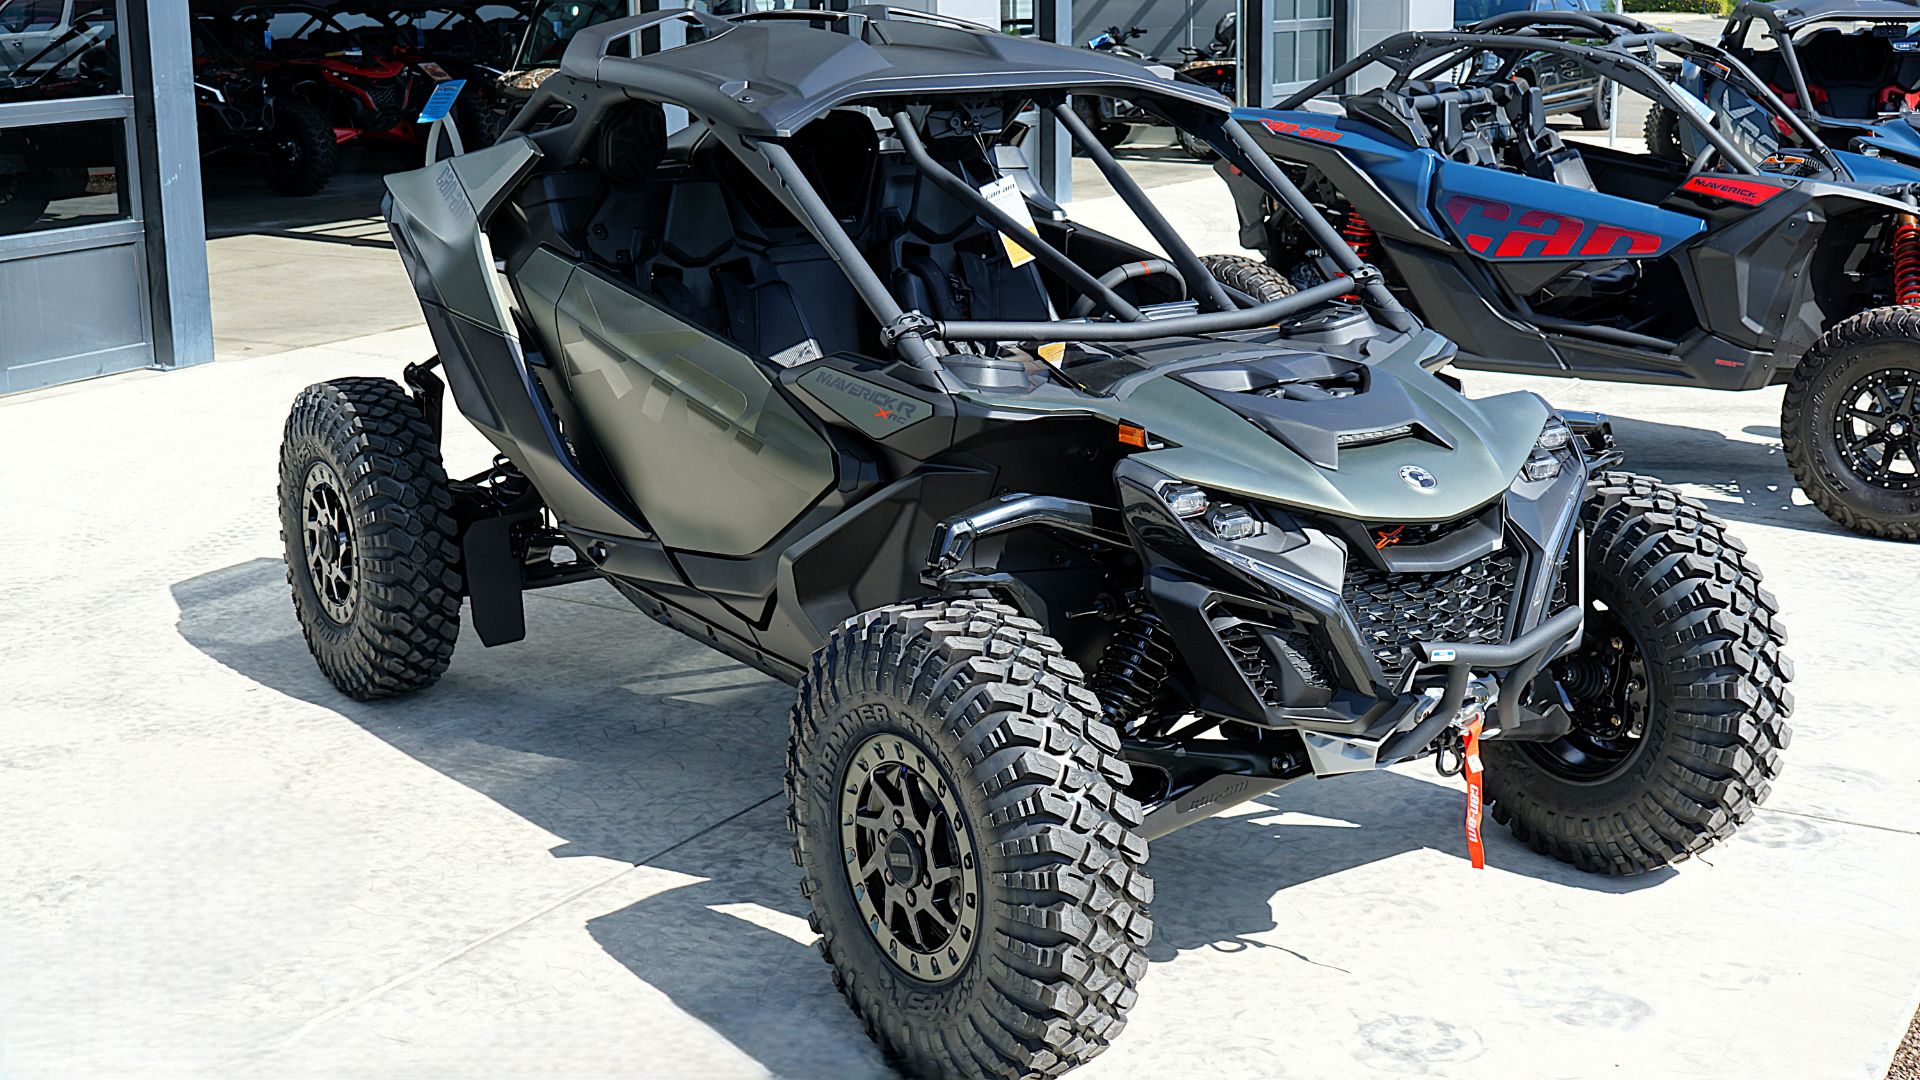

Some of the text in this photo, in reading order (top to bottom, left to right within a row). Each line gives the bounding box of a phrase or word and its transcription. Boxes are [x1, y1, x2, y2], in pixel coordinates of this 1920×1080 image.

[1694, 178, 1758, 199] MAVERICK
[815, 371, 898, 410] MAVERICK
[1468, 783, 1481, 843] can-am
